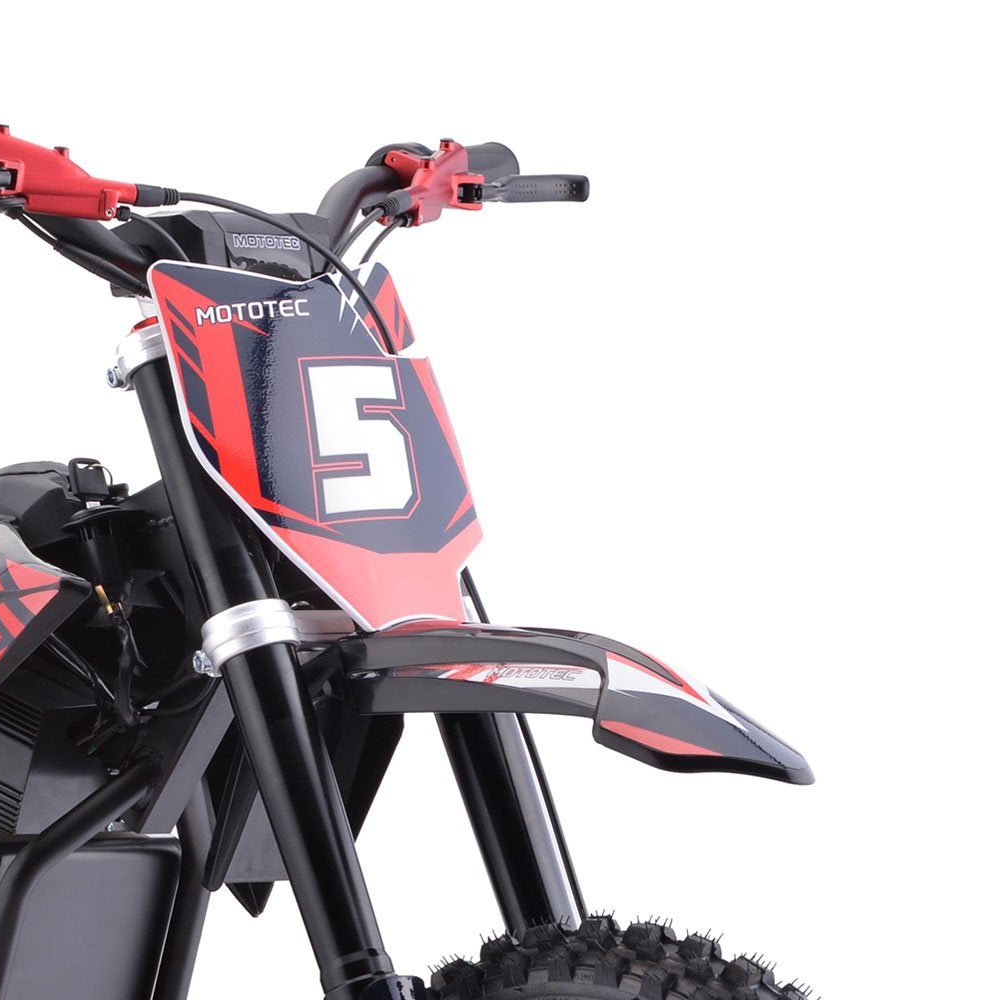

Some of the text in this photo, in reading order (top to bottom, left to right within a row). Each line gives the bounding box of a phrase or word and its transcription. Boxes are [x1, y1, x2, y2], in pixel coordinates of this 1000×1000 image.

[232, 233, 301, 251] MOTOTEC
[196, 299, 310, 326] MOTOTEC
[304, 362, 417, 519] 5
[486, 666, 584, 682] MOTOTEC
